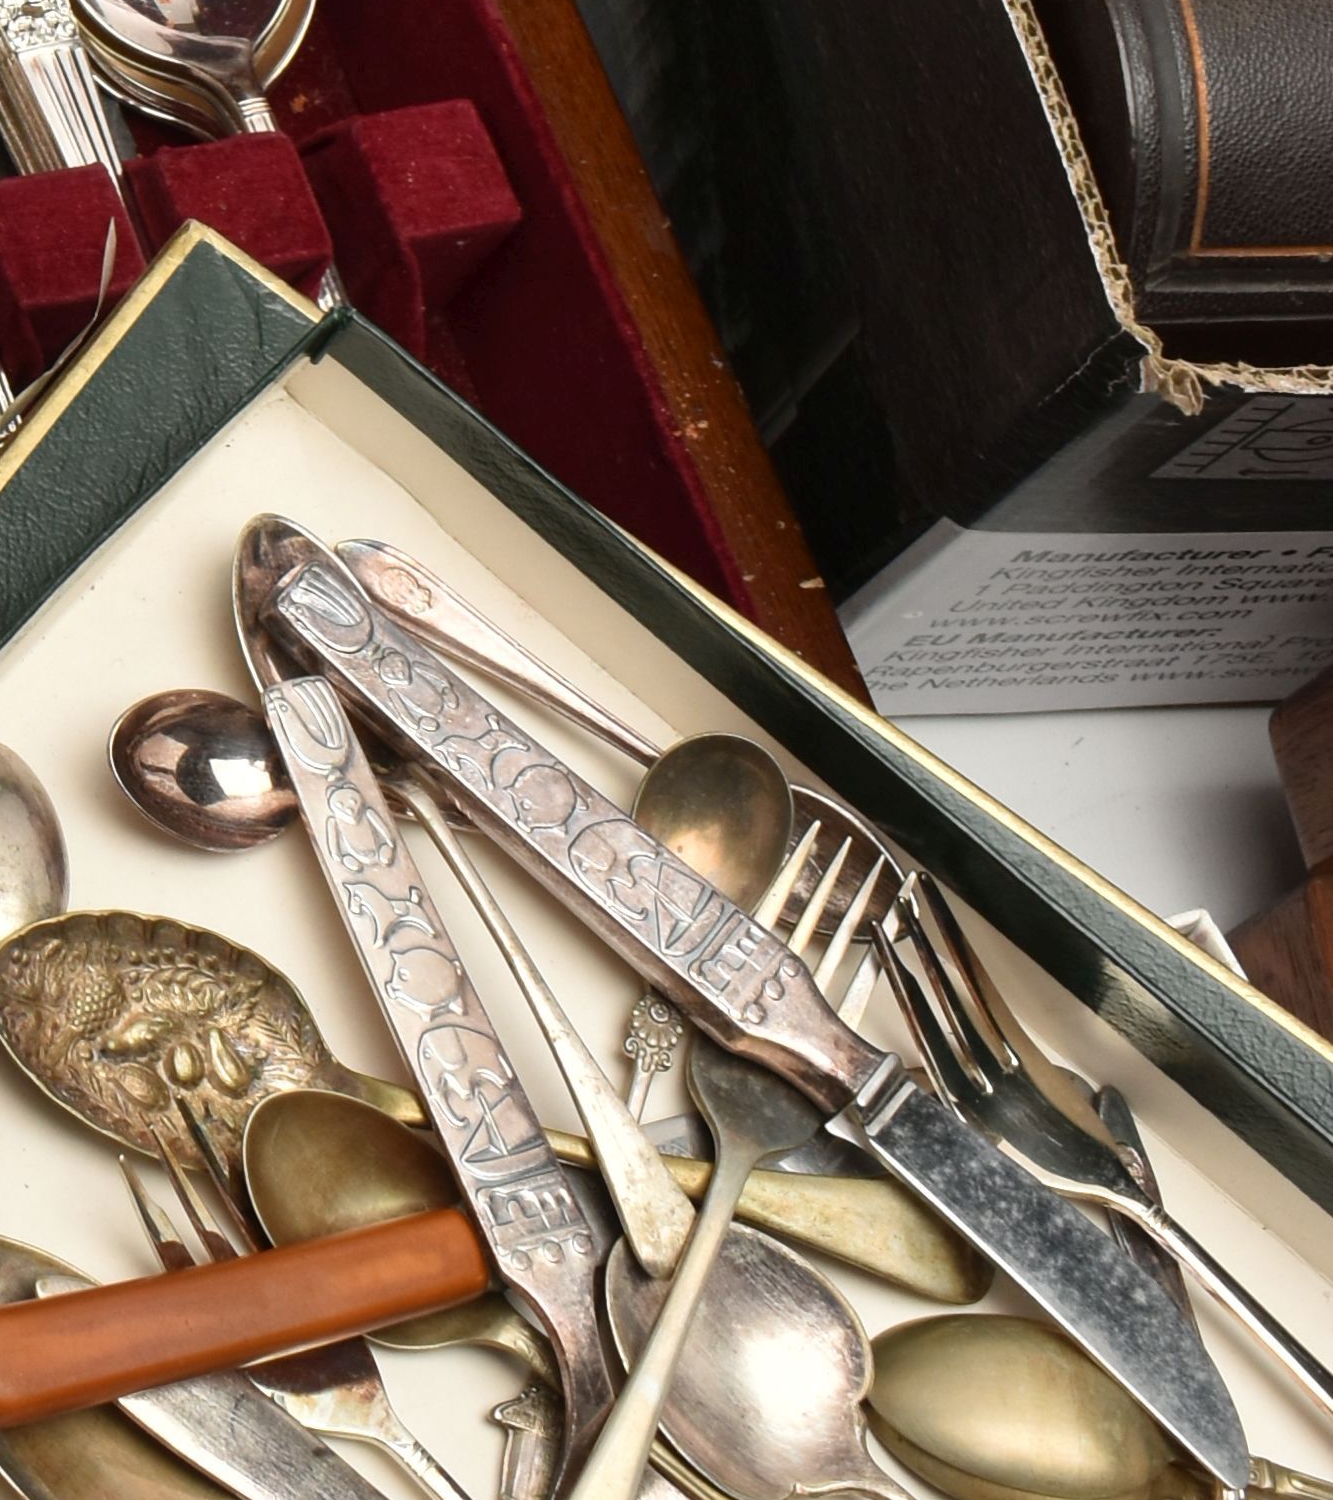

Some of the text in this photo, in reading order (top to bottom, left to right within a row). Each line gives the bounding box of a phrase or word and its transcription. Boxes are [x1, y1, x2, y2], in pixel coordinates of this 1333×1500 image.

[1009, 549, 1272, 564] Manufacturer
[988, 563, 1171, 583] Kingfisher
[1001, 580, 1204, 597] Paddington
[949, 597, 1068, 613] United
[1072, 594, 1229, 610] Kingdom
[930, 608, 1253, 628] www.screwfix.com
[904, 627, 1223, 647] EU Manufacturer:
[883, 645, 1055, 663] Kingfisher
[1062, 634, 1275, 657] International
[917, 672, 1118, 690] Netherlands
